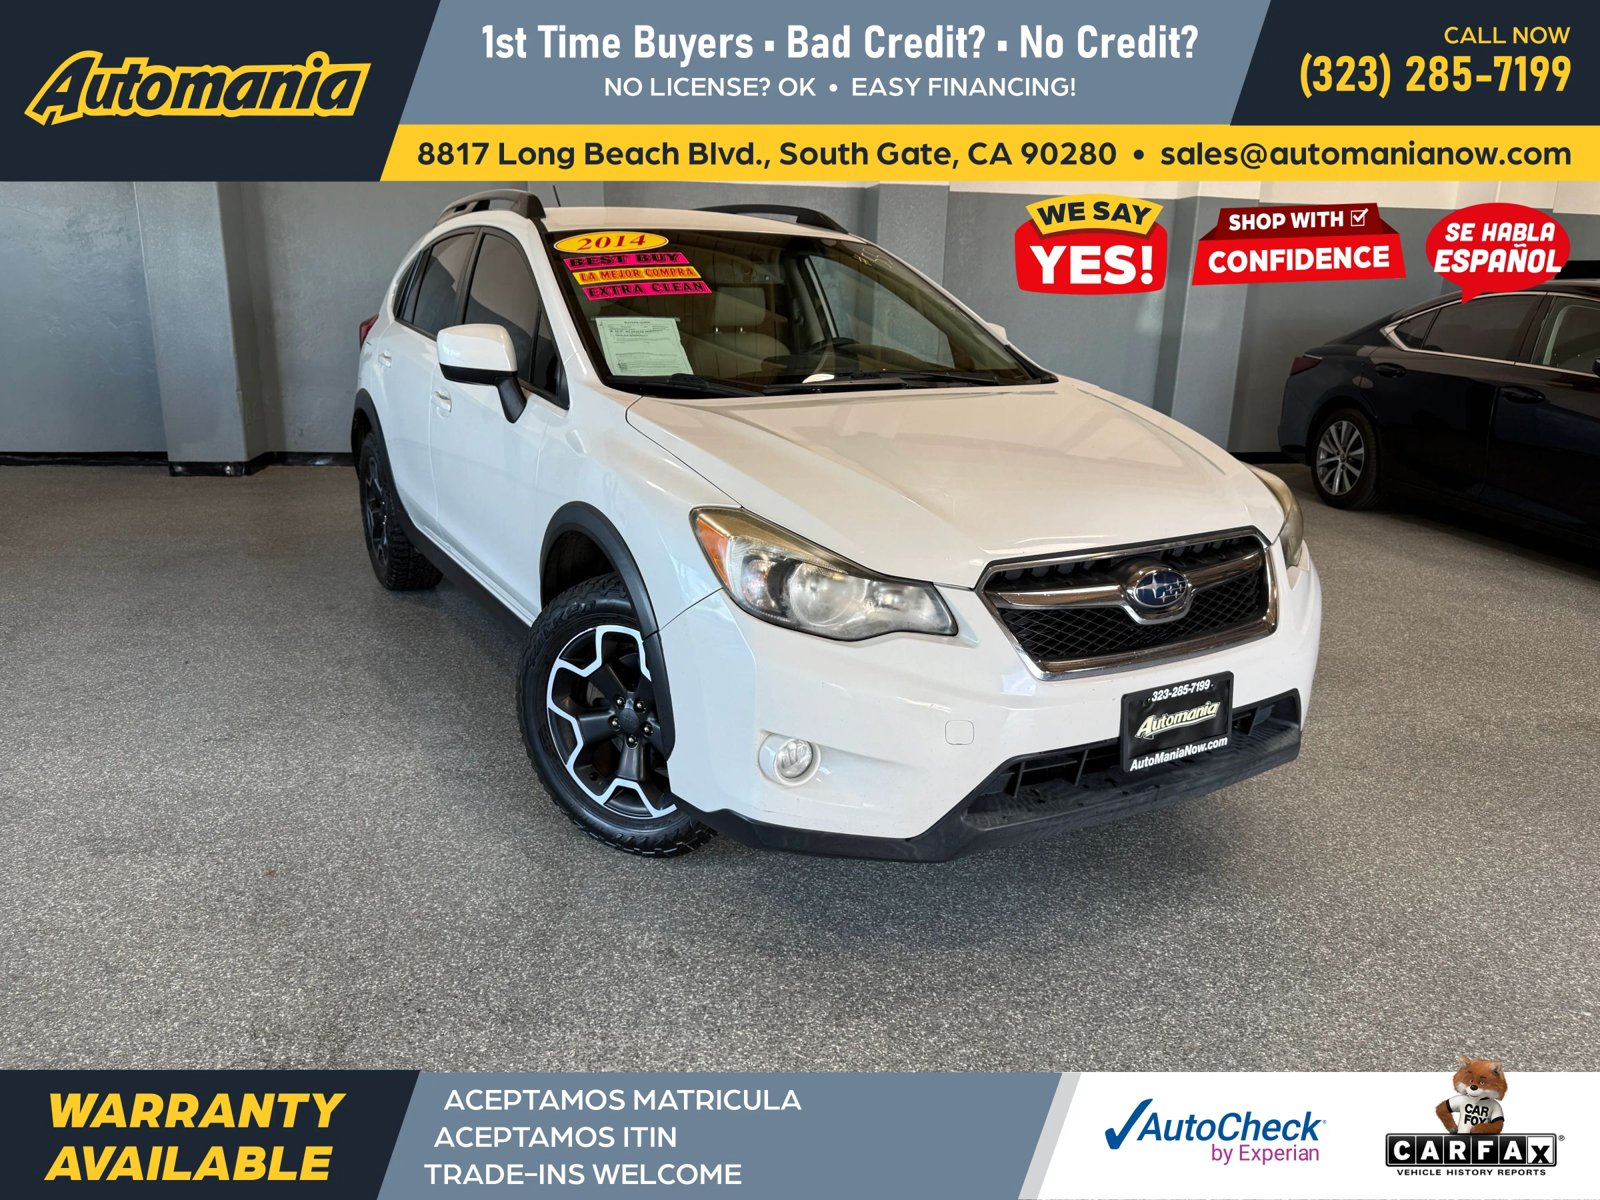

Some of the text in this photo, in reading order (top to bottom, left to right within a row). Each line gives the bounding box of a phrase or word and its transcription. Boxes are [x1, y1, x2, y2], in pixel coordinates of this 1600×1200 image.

[577, 234, 646, 251] 2014
[569, 253, 681, 267] BEST BUY
[580, 267, 695, 281] LA MEJOR COMPRA
[588, 282, 704, 297] EXTRA CLEAN
[1151, 679, 1211, 702] 323-285-7199
[1135, 701, 1220, 739] Automania
[1130, 737, 1228, 771] AutoManiaNow.com
